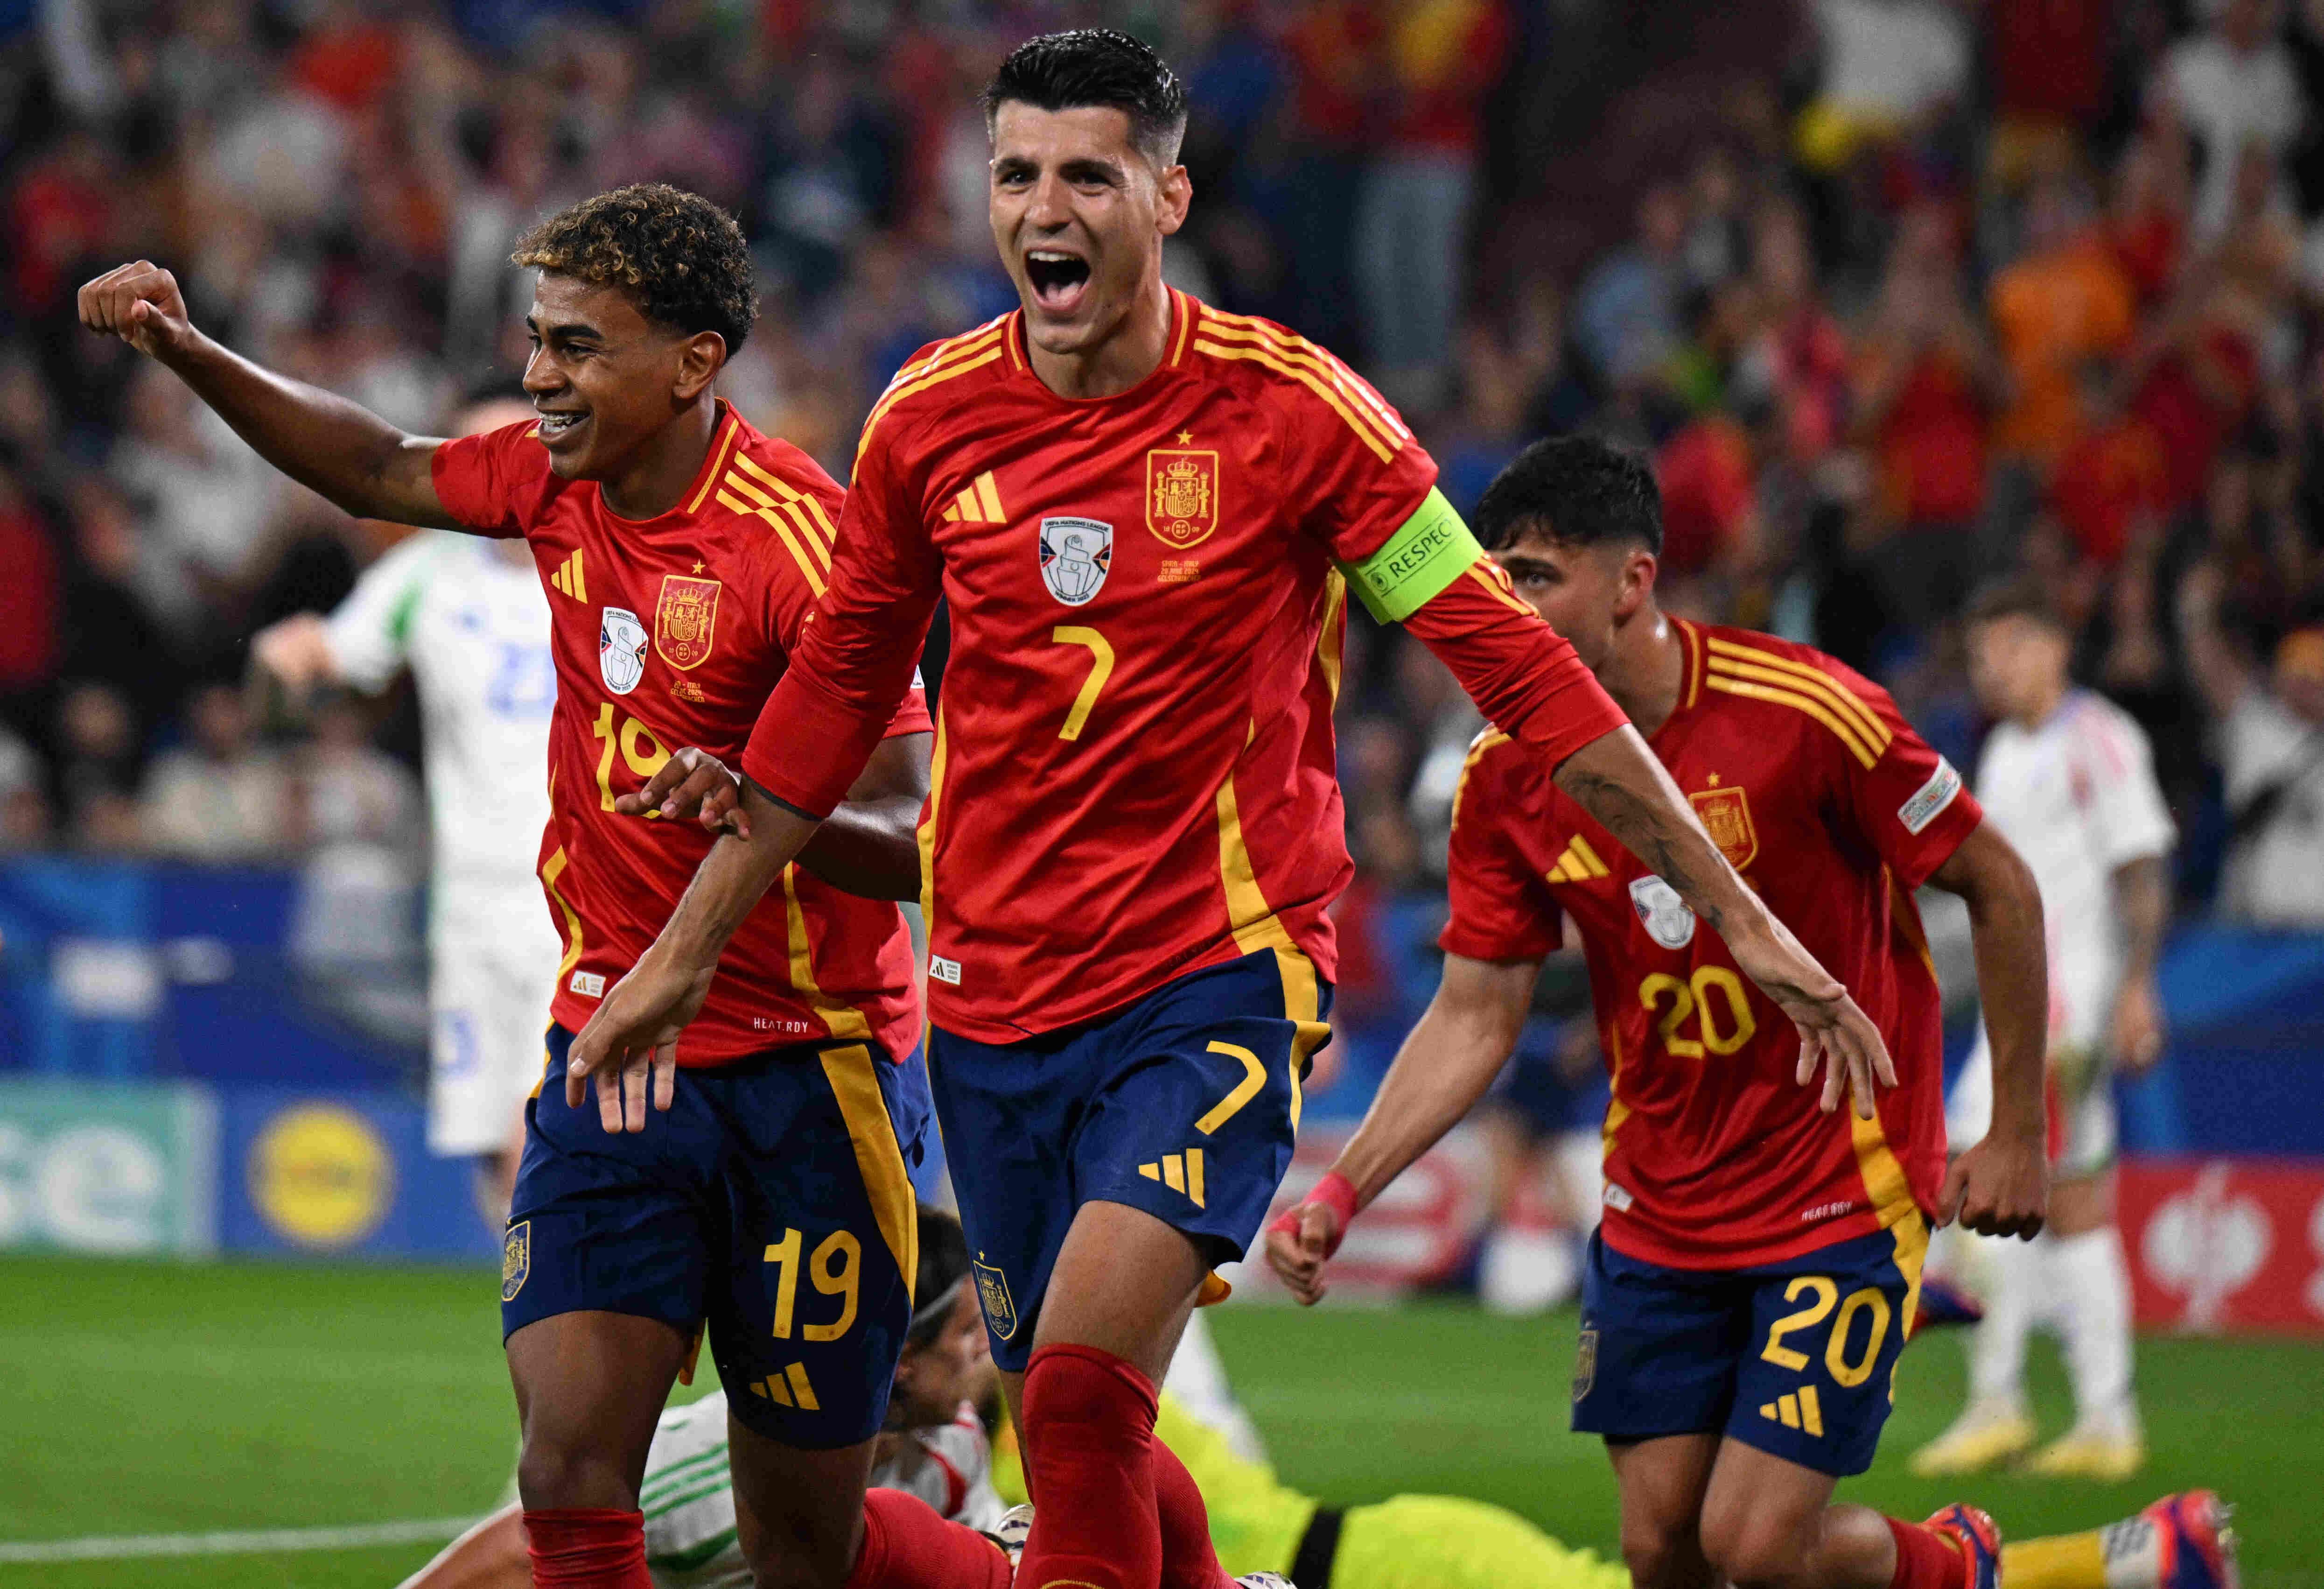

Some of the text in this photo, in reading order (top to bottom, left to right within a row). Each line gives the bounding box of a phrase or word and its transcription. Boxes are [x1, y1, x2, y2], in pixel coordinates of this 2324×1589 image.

[1087, 522, 1109, 532] LEAGUE
[1389, 518, 1452, 578] RESPEC
[616, 612, 631, 620] NATIONS
[1056, 591, 1075, 602] WINNER
[1052, 626, 1115, 742] 7
[593, 702, 672, 819] 19
[754, 1017, 808, 1034] HEAT.RDY
[1639, 965, 1756, 1059] 20
[1195, 1040, 1268, 1135] 7
[763, 1227, 861, 1342] 19
[1761, 1275, 1891, 1388] 20
